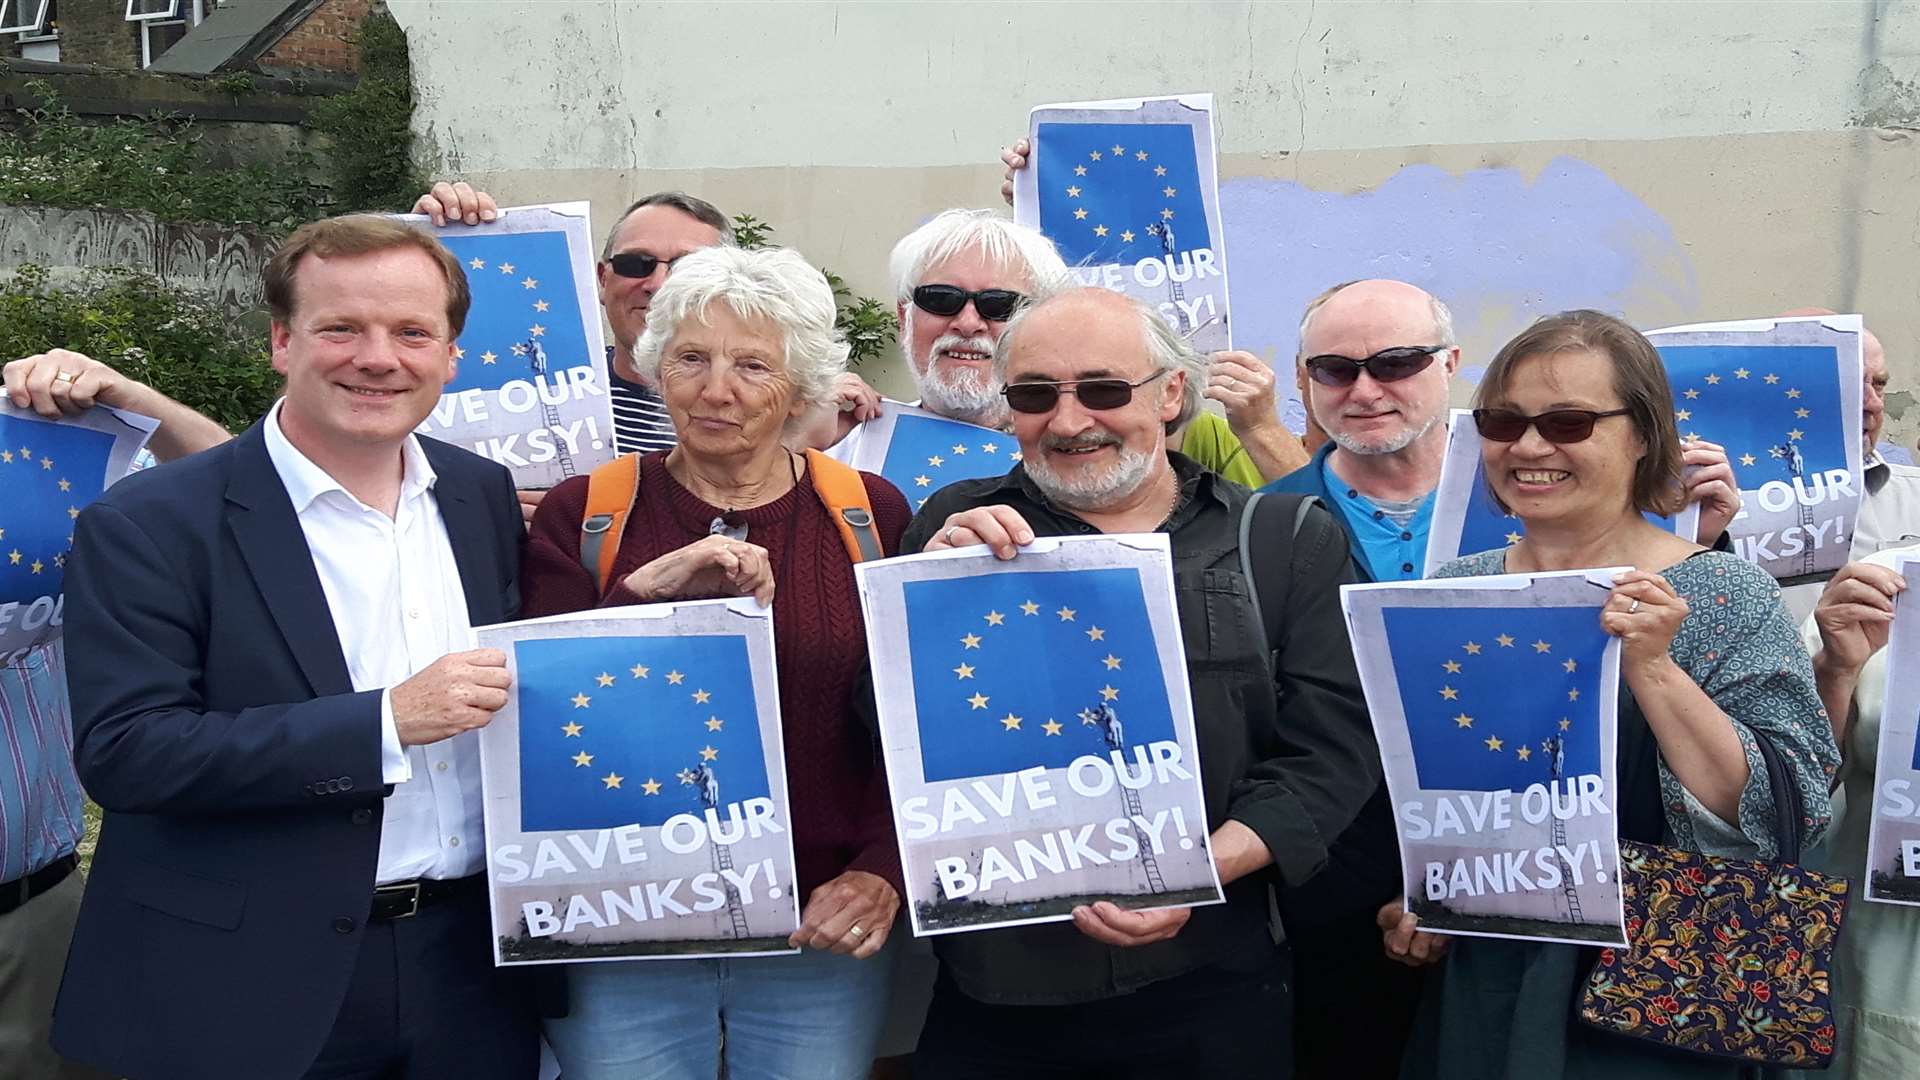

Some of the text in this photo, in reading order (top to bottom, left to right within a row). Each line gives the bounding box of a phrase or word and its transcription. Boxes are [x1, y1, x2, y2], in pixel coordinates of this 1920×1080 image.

[1134, 248, 1221, 287] OUR
[417, 365, 605, 432] VE OUR
[475, 416, 604, 467] KSY!
[1758, 468, 1858, 512] OUR
[1734, 515, 1844, 563] KSY!
[900, 740, 1193, 840] SAVE OUR
[1400, 774, 1611, 840] SAVE OUR
[494, 797, 784, 883] SAVE OUR
[934, 806, 1194, 900] BANKSY!
[1425, 840, 1607, 901] BANKSY!
[522, 858, 782, 938] BANKSY!
